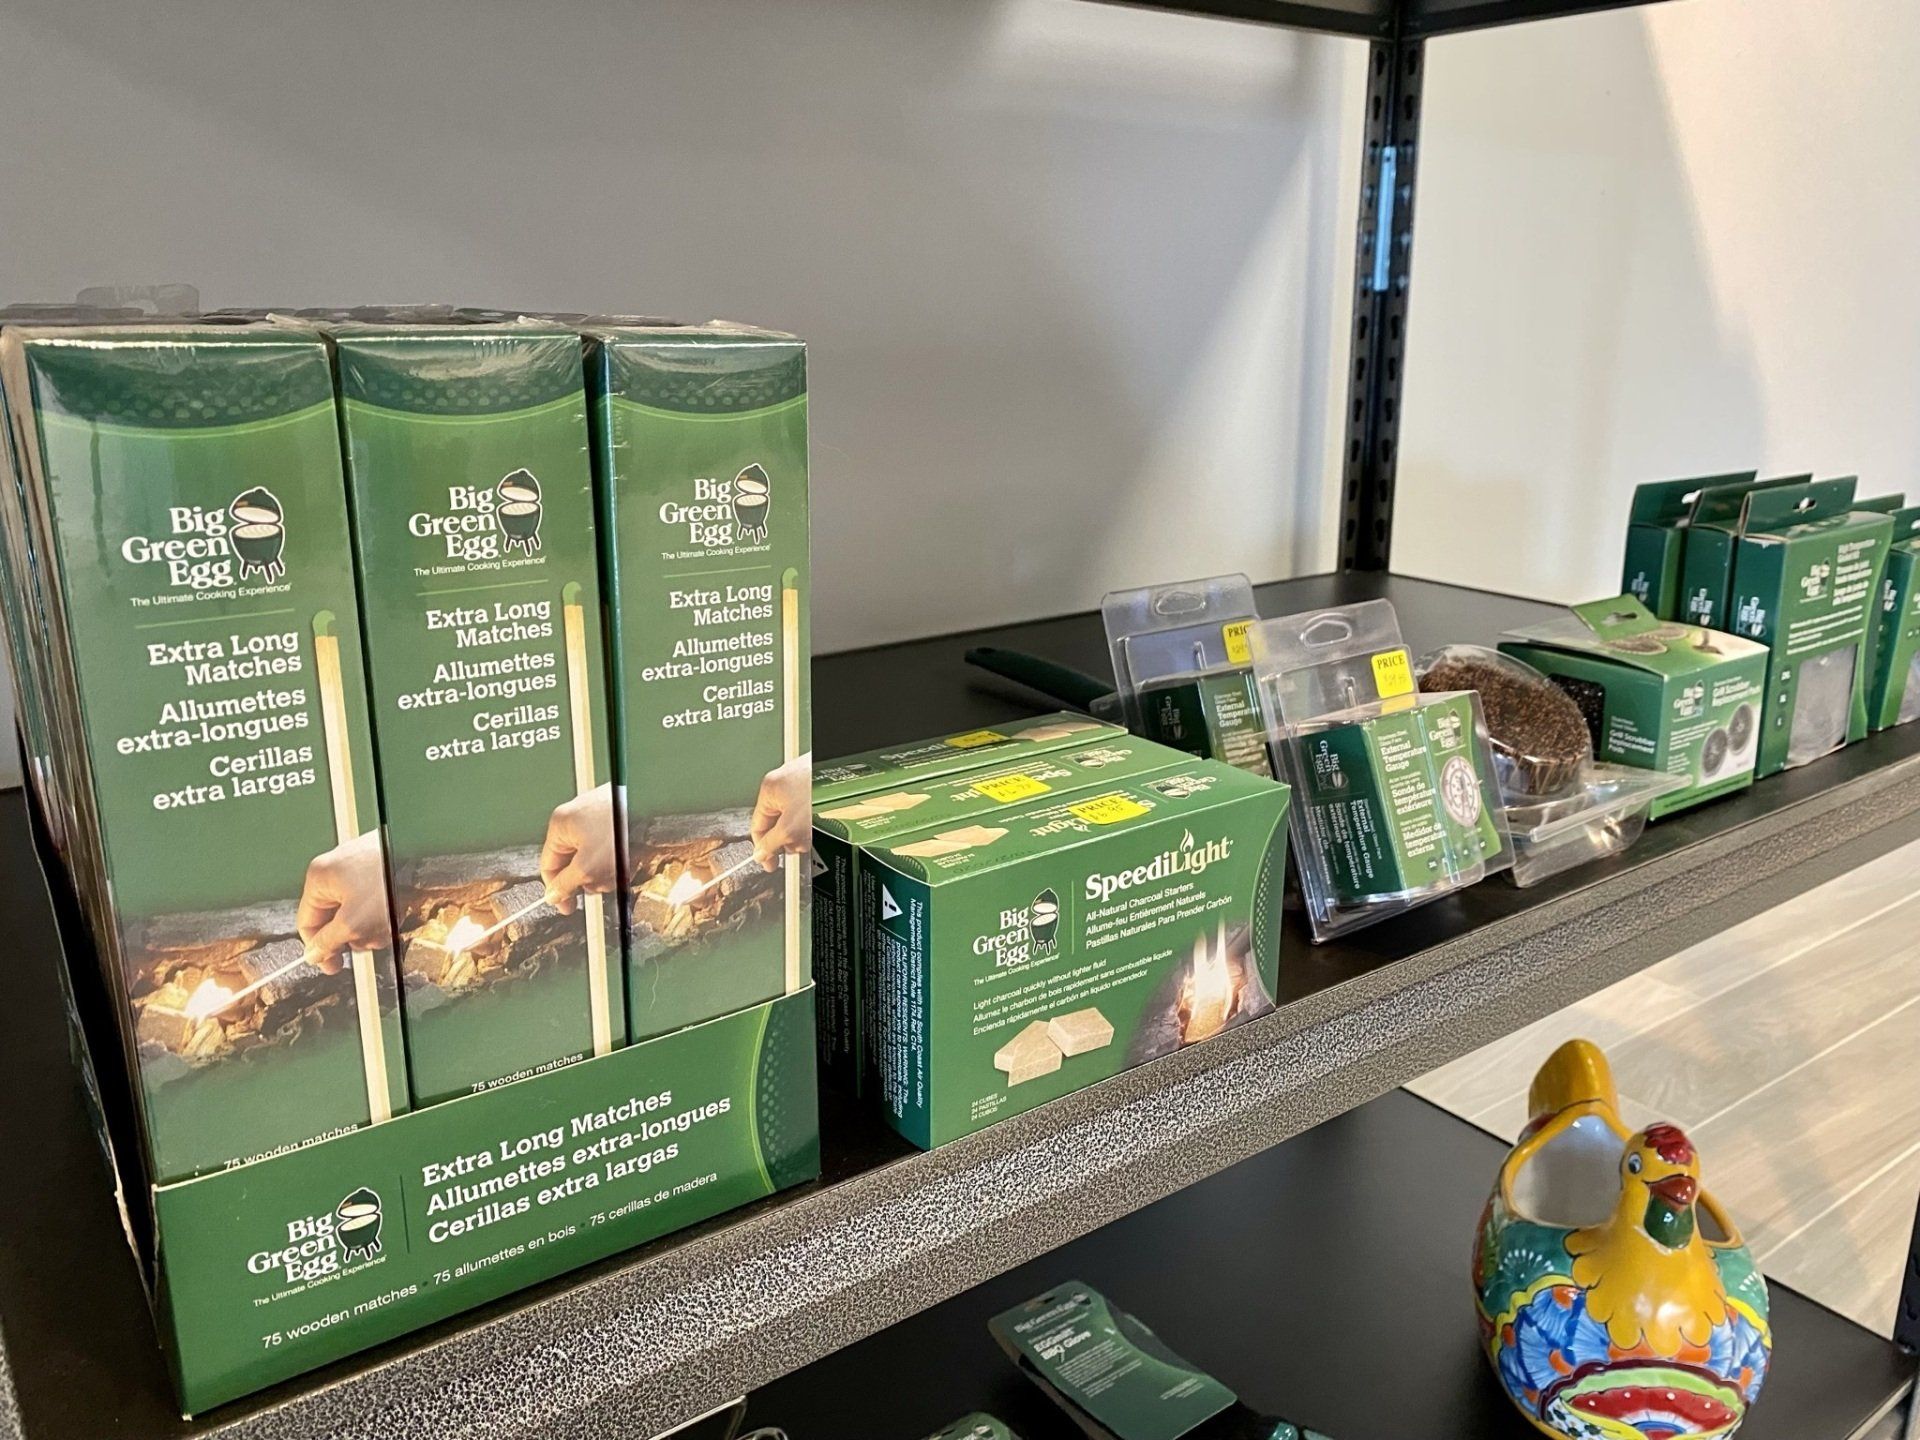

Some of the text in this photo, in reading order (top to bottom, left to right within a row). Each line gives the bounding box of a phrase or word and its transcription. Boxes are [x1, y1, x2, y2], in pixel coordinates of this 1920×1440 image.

[448, 486, 495, 513] Big
[694, 478, 732, 503] Big
[169, 506, 228, 537] Big
[408, 513, 497, 537] Green
[659, 502, 732, 524] Green
[121, 536, 231, 563] Green
[446, 534, 499, 560] Egg
[689, 522, 733, 547] Egg
[413, 557, 546, 576] The Ultimate Cooking Experience
[661, 545, 771, 560] The Ultimate Cooking Experience
[168, 559, 234, 589] Egg
[130, 583, 291, 607] The Ultimate Cooking Experience
[669, 585, 773, 609] Extra Long
[426, 601, 550, 629] Extra Long
[694, 604, 773, 626] Matches
[148, 632, 299, 665] Extra Long
[456, 622, 553, 648] Matches
[672, 632, 773, 658] Allumettes
[184, 655, 302, 686] Matches
[433, 652, 555, 683] Allumettes
[641, 651, 774, 682] extra-longues
[1377, 655, 1405, 669] PRICE
[398, 673, 557, 710] extra-longues
[703, 679, 774, 703] Cerillas
[159, 689, 306, 725] Allumettes
[473, 705, 559, 731] Cerillas
[662, 699, 774, 729] extra largas
[117, 711, 309, 755] extra-longues
[425, 725, 561, 761] extra largas
[209, 746, 313, 777] Cerillas
[1315, 753, 1325, 774] Egg
[1319, 740, 1332, 771] Green
[1330, 753, 1340, 771] Big
[153, 768, 315, 810] extra largas
[982, 776, 1025, 791] PRICE
[1078, 798, 1119, 813] PRICE
[1356, 799, 1370, 833] External
[1350, 800, 1368, 851] Temperature
[1363, 852, 1374, 879] Gauge
[1085, 832, 1233, 902] SpeediLight
[1085, 882, 1194, 922] All-Natural Charcoal Starters
[1085, 916, 1128, 936] Allume-feu
[1175, 891, 1206, 907] Naturels
[999, 906, 1030, 931] Big
[1085, 896, 1232, 949] Pastillas Naturales Para Prender Carbón
[972, 927, 1030, 955] Green
[995, 943, 1031, 967] Egg
[973, 953, 1060, 986] The Ultimate Cooking Experience
[974, 959, 1107, 1010] Light charcoal quickly without lighter fluid
[973, 949, 1173, 1023] Allumez le charbon de bois rapidement sans combustible liquide
[973, 1019, 1006, 1035] Encienda
[1056, 993, 1079, 1007] carbón
[1080, 989, 1089, 999] sin
[1112, 968, 1148, 987] encendedor
[471, 1053, 584, 1093] 75 wooden matches
[915, 1081, 923, 1108] Quality
[223, 1123, 359, 1170] 75 wooden matches
[422, 1089, 672, 1187] Extra Long Matches
[426, 1096, 731, 1215] Allumettes extra-longues
[428, 1143, 679, 1244] Cerillas extra largas
[286, 1212, 335, 1243] Big
[247, 1234, 336, 1275] Green
[262, 1172, 718, 1349] 75 wooden matches 75 allumettes en bois 75 cerillas de madera
[284, 1249, 341, 1284] Egg
[253, 1255, 387, 1307] The Ultimate Cooking Experience
